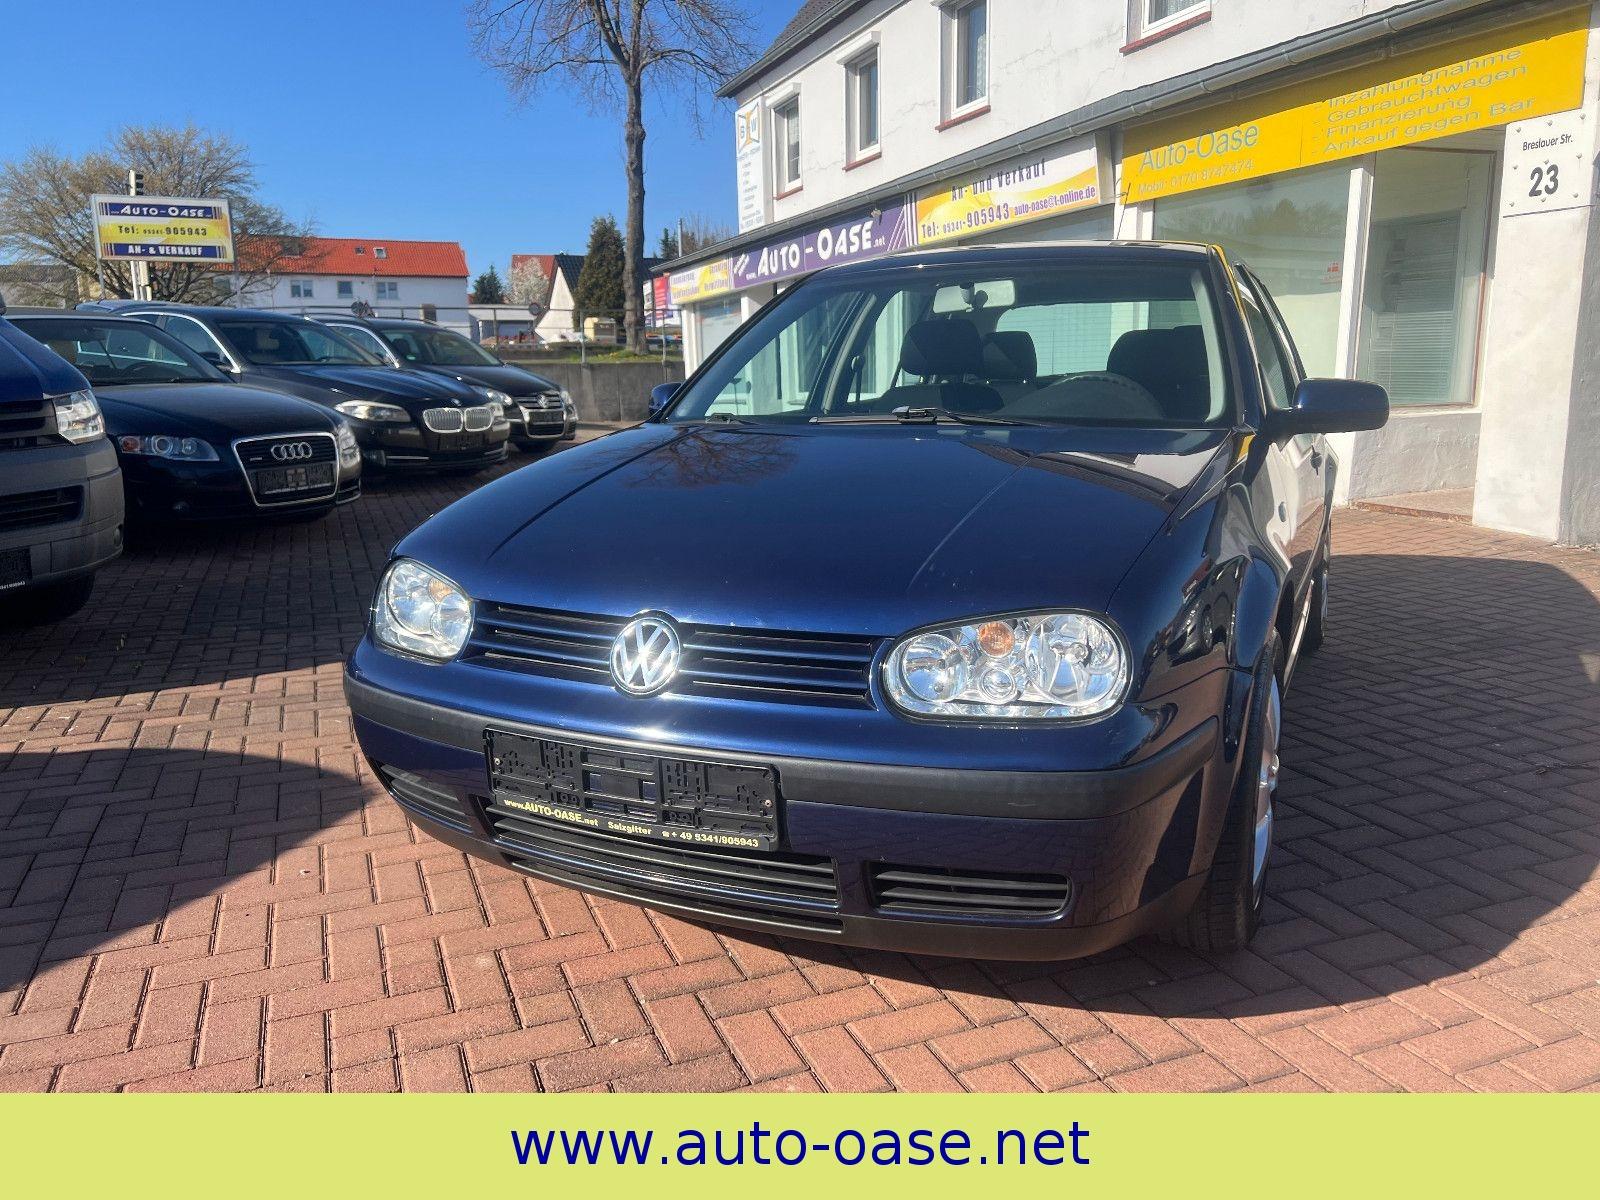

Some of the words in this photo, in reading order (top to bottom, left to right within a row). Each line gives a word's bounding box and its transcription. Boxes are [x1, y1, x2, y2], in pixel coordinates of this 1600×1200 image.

[1328, 65, 1528, 123] Gebrauchtwagen
[1329, 49, 1522, 108] Inzahlungnahme
[1324, 128, 1398, 153] Ankauf
[1404, 111, 1480, 137] gegen
[1490, 97, 1535, 117] Bar
[1327, 97, 1471, 138] Finanzierung
[1139, 125, 1258, 174] Auto-Oase
[1523, 137, 1559, 151] Breslauer
[1560, 134, 1573, 144] Str.
[952, 185, 968, 202] An-
[972, 178, 992, 196] und
[997, 158, 1046, 189] Verkauf
[1529, 164, 1559, 197] 23
[118, 225, 139, 235] Tel:
[922, 222, 940, 239] Tel:
[1014, 186, 1096, 216] auto-oase@t-online.de
[148, 247, 157, 255] &
[158, 246, 203, 256] VERKAUF
[503, 799, 599, 827] www.AUTO-OASE.net
[607, 821, 652, 835] Salzgitter
[679, 831, 693, 841] 49
[694, 832, 759, 848] 5341/905943
